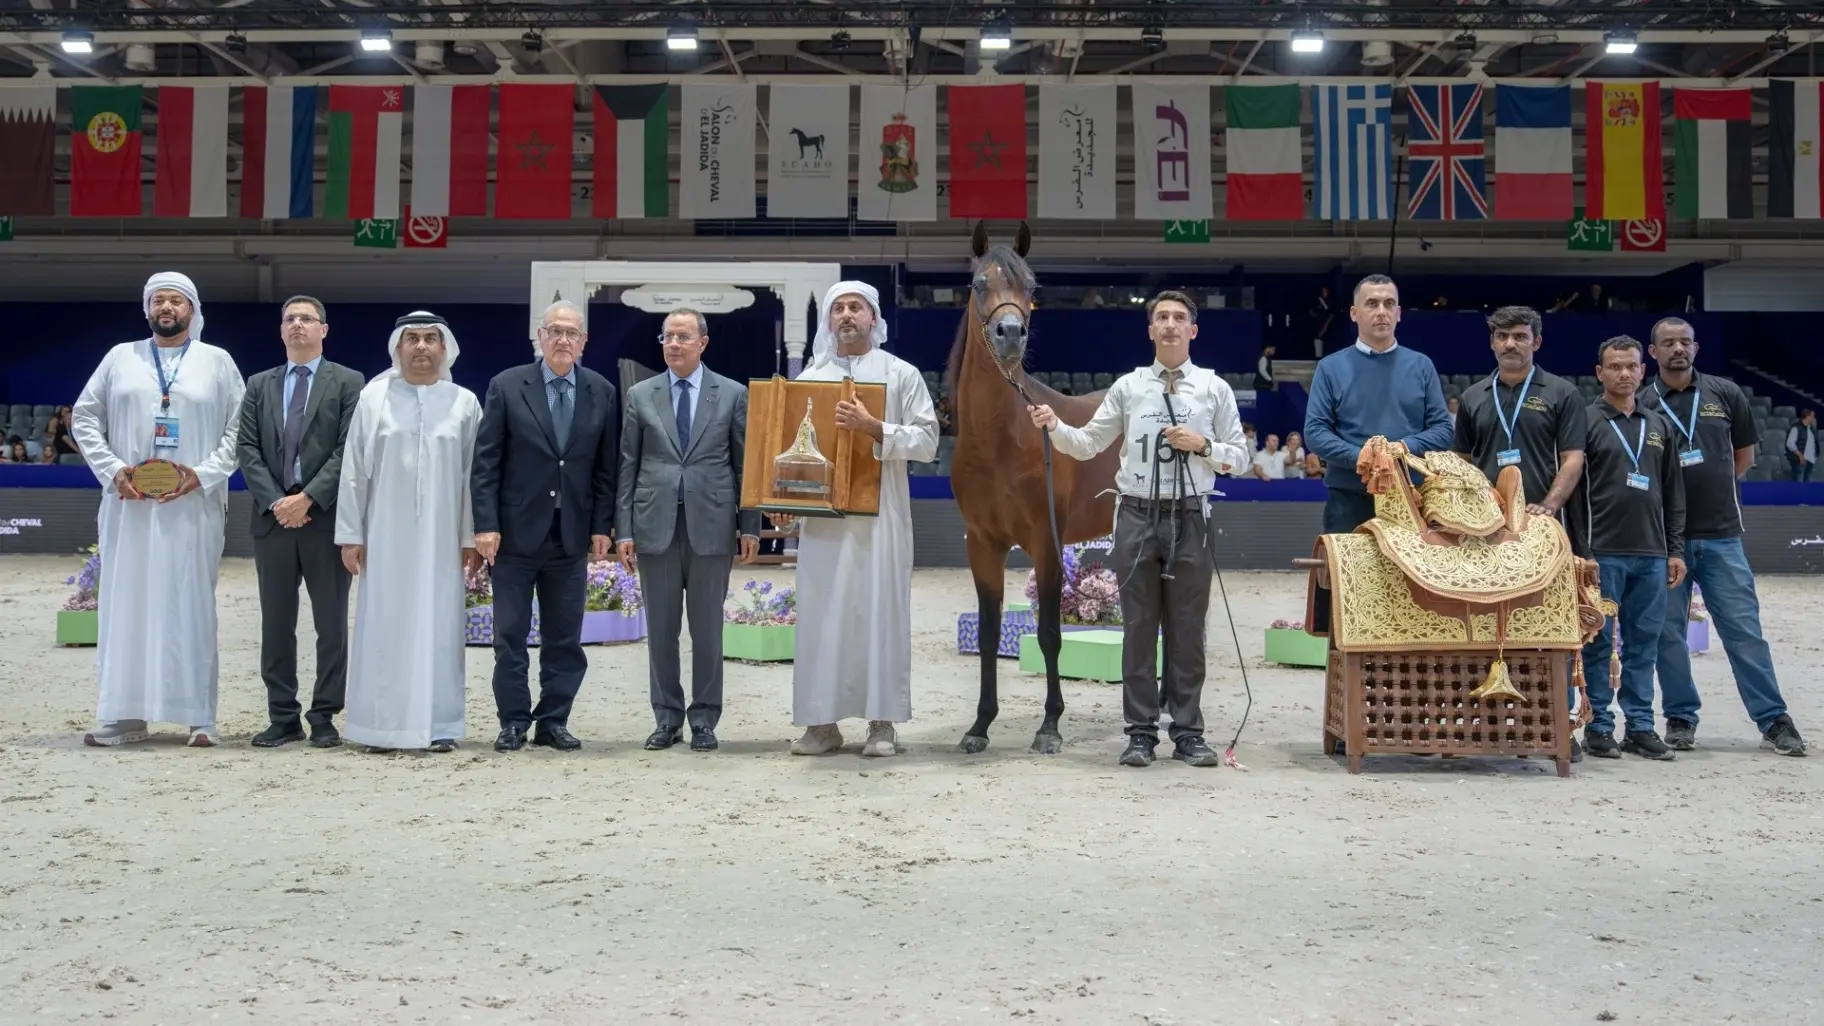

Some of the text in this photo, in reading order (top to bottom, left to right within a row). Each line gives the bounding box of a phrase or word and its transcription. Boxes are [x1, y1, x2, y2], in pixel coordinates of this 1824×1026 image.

[700, 129, 710, 171] JADIDA
[1072, 118, 1084, 209] معرض الفرس
[1156, 99, 1190, 201] FEI
[710, 160, 720, 202] CHEVAL
[1084, 540, 1112, 549] JADID
